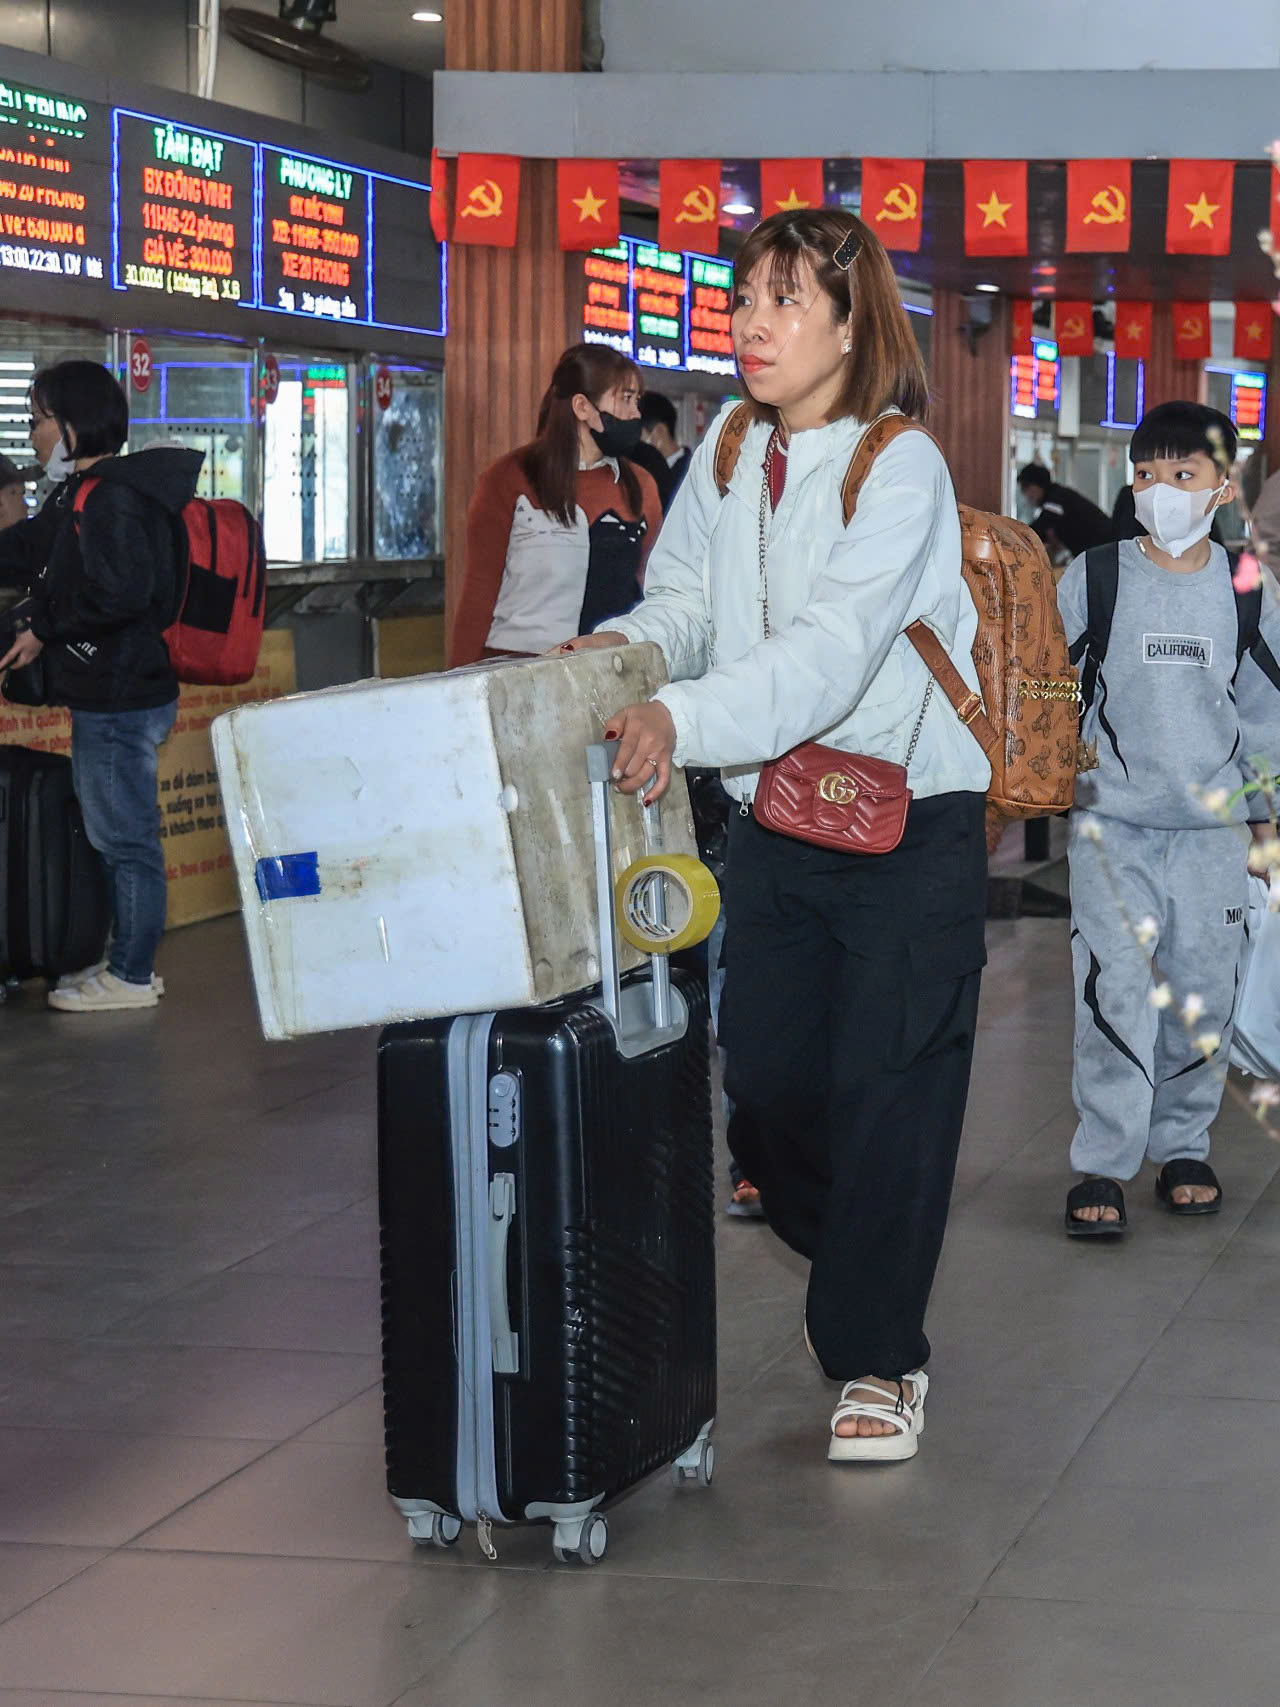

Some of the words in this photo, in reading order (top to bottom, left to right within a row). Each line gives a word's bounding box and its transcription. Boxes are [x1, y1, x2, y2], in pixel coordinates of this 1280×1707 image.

[132, 354, 150, 378] 32
[376, 377, 391, 398] 34
[1147, 643, 1206, 661] CALIFORNIA
